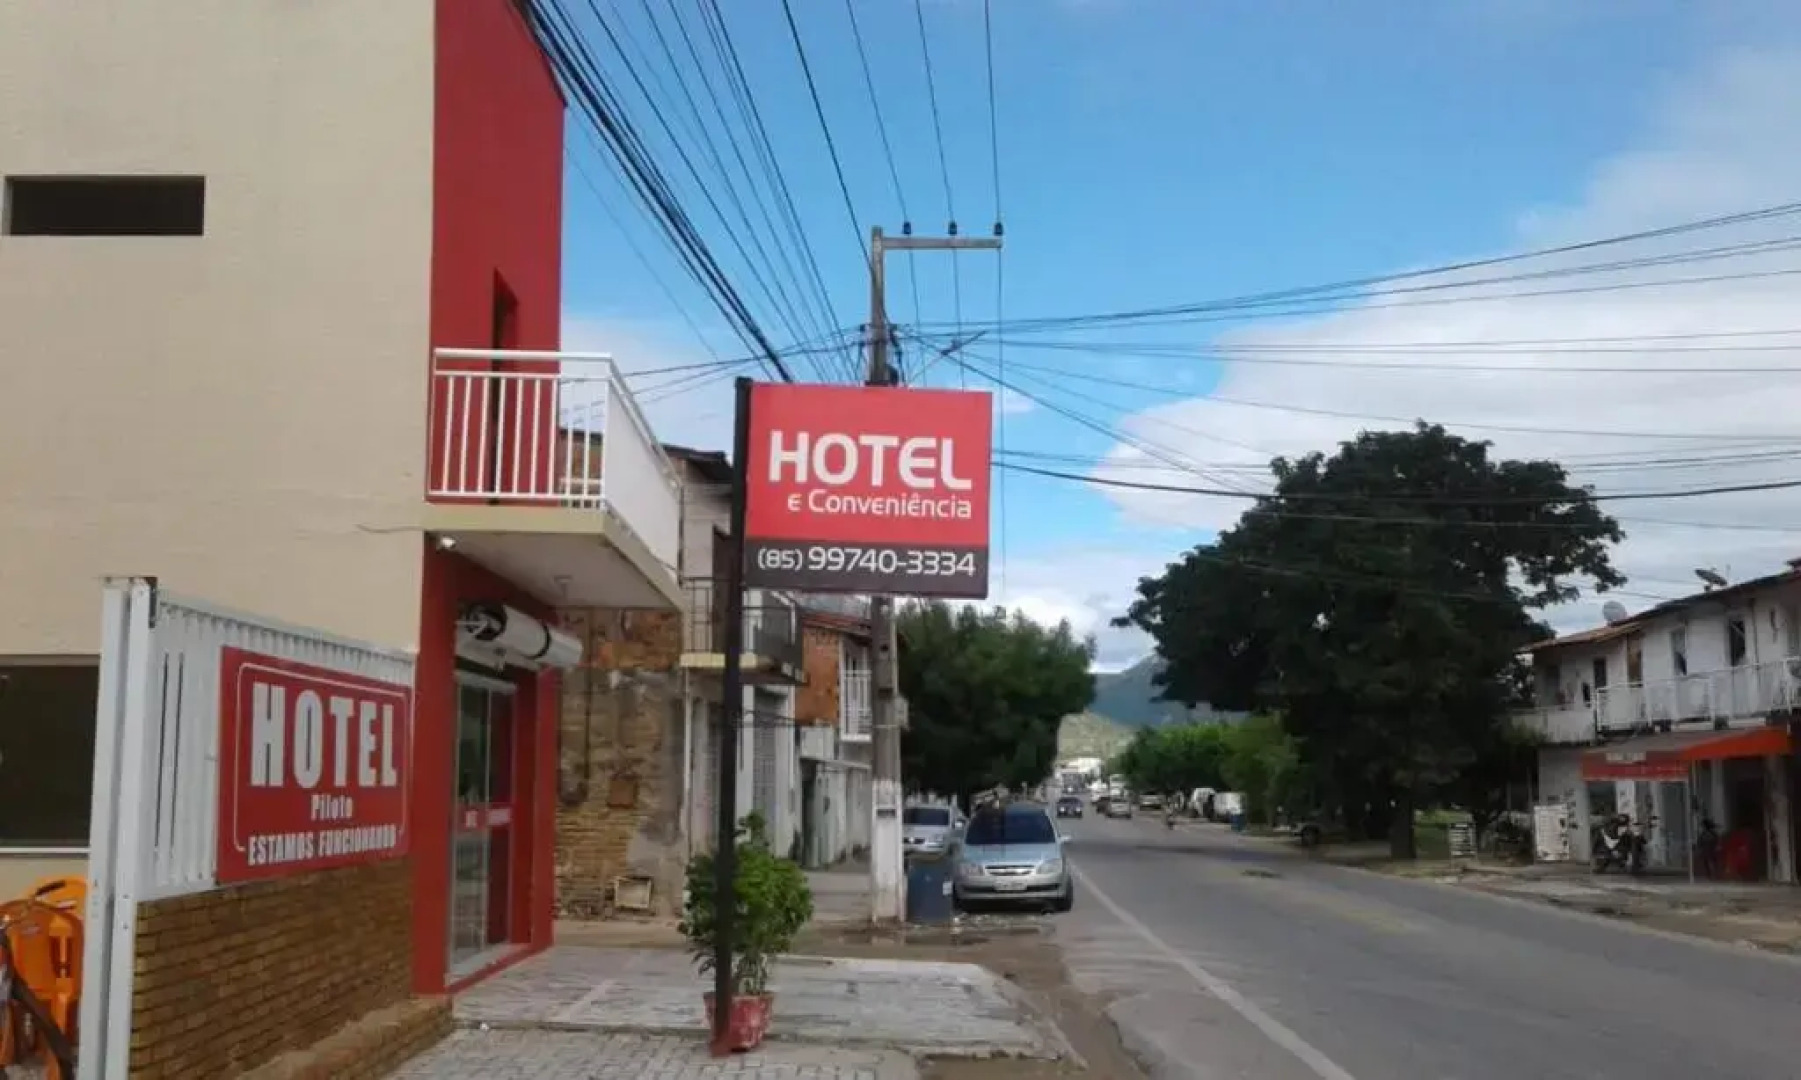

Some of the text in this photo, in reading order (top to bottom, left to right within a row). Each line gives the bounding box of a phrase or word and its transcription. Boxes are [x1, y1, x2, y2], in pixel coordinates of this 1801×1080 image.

[769, 431, 972, 489] HOTEL
[808, 490, 972, 518] Conveniência
[758, 547, 976, 575] (85) 99740-3334
[251, 683, 396, 788] HOTEL
[311, 795, 353, 820] Piloto
[249, 825, 396, 866] ESTAMOS FUNCIONANDO
